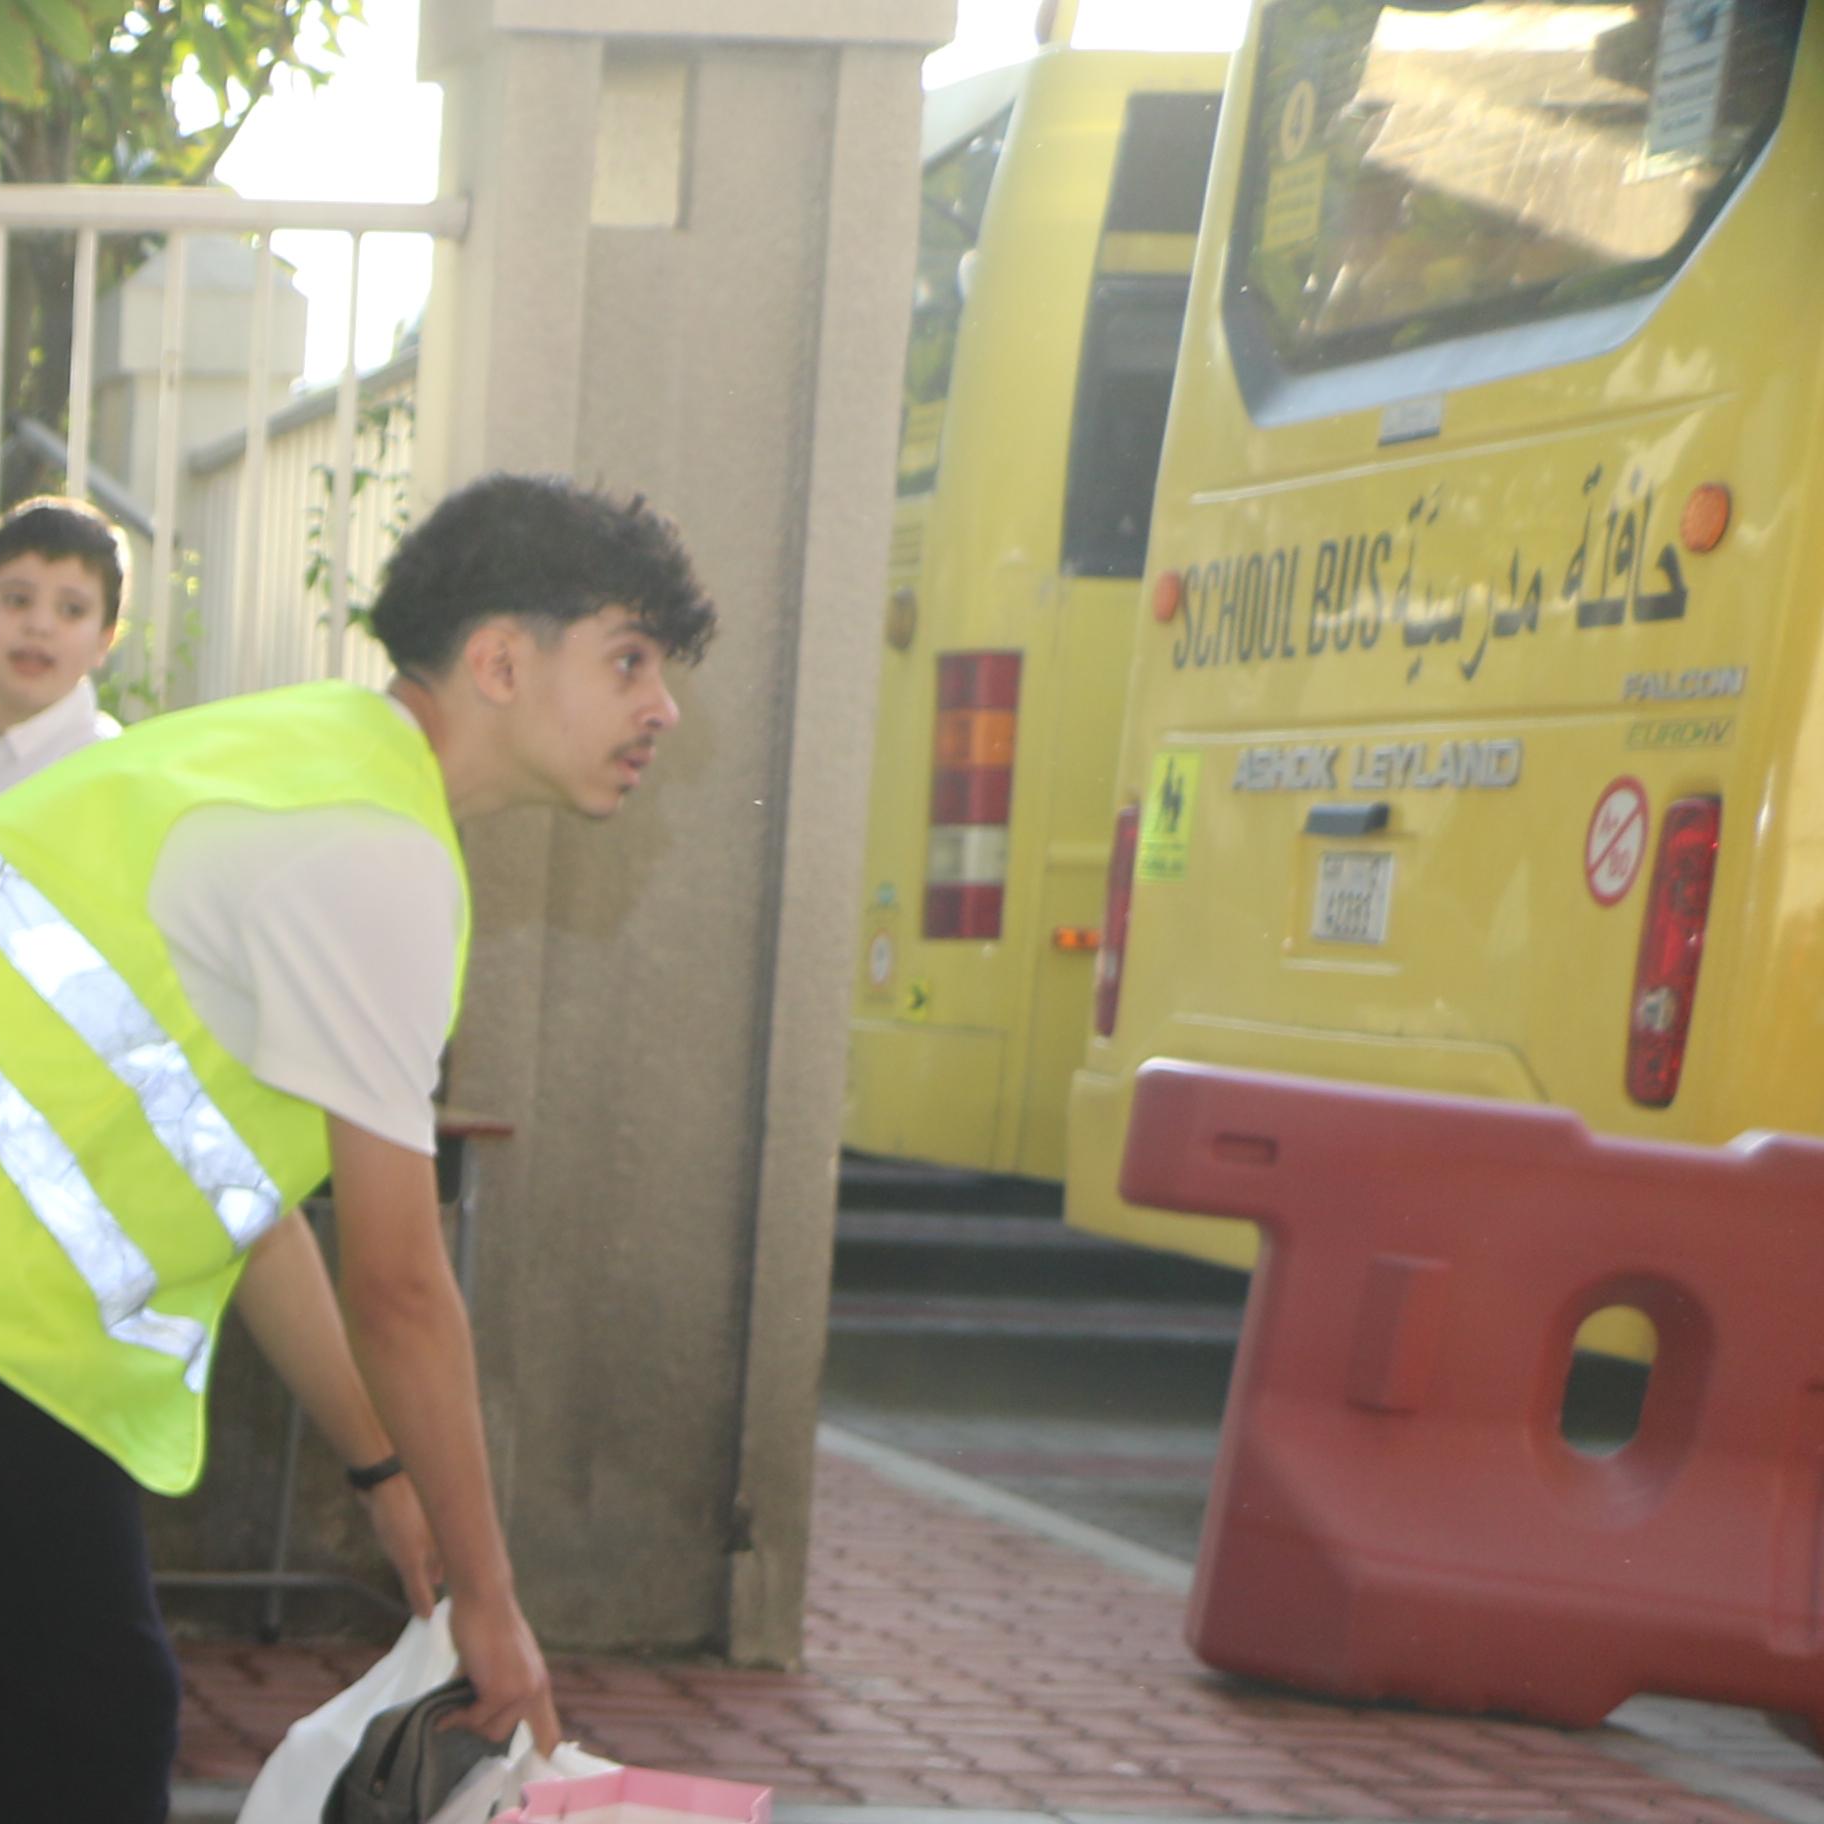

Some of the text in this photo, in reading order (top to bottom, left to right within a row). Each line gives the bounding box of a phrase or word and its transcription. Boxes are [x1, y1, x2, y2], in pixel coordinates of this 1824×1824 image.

[1173, 531, 1391, 670] SCHOOL BUS
[1393, 462, 1688, 684] حافلة مدرسية
[1622, 666, 1748, 702] FALCON
[1232, 739, 1523, 791] ASHOK LEYLAND
